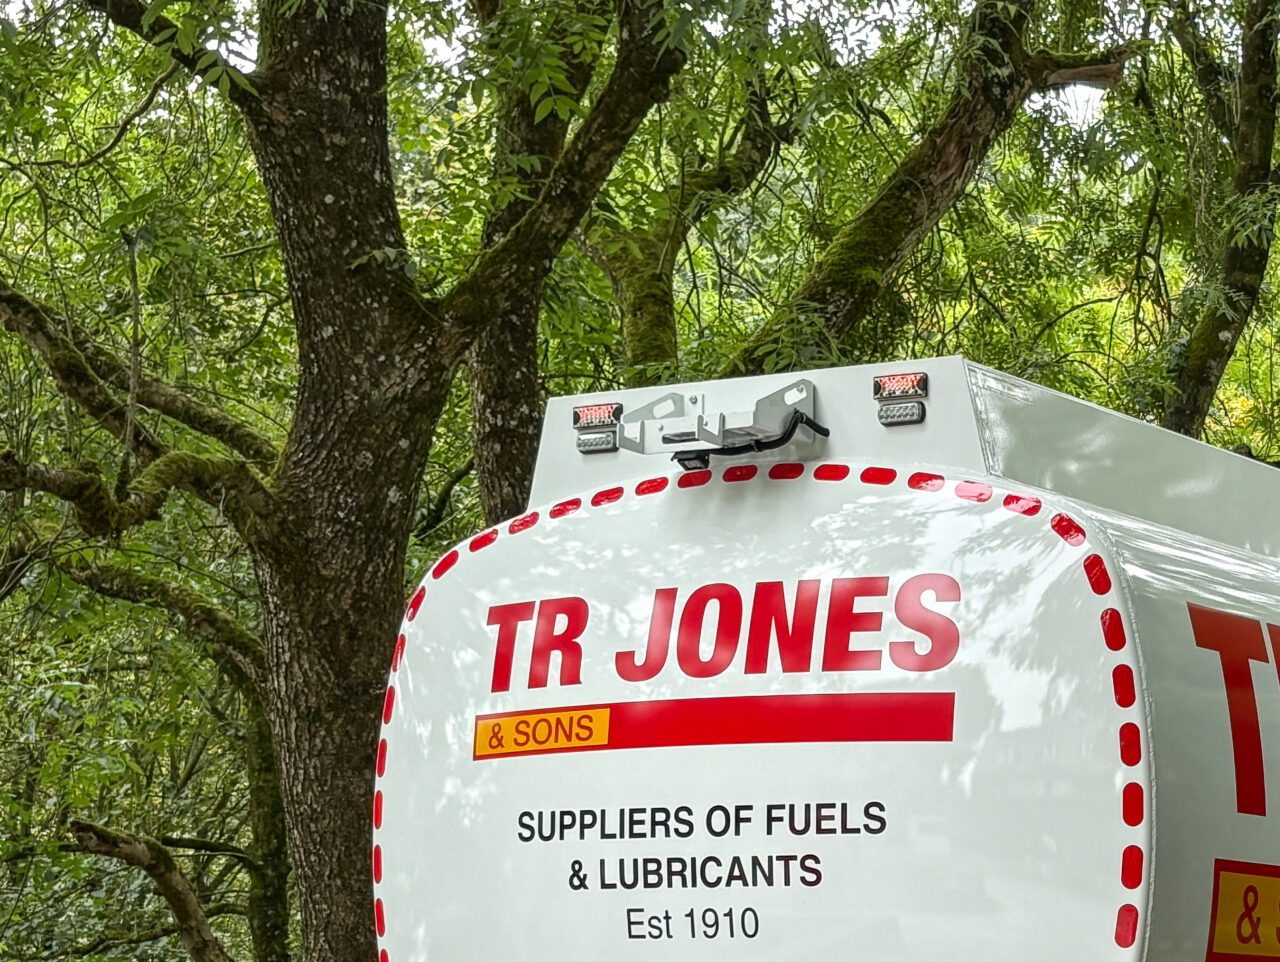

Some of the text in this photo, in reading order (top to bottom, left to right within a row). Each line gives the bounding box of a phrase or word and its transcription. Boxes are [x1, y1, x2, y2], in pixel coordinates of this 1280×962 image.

[487, 574, 961, 693] TR JONES
[487, 715, 594, 750] & SONS
[517, 801, 887, 843] SUPPLIERS OF FUELS
[568, 854, 822, 891] & LUBRICANTS
[626, 907, 759, 940] Est 1910
[1236, 885, 1261, 944] &
